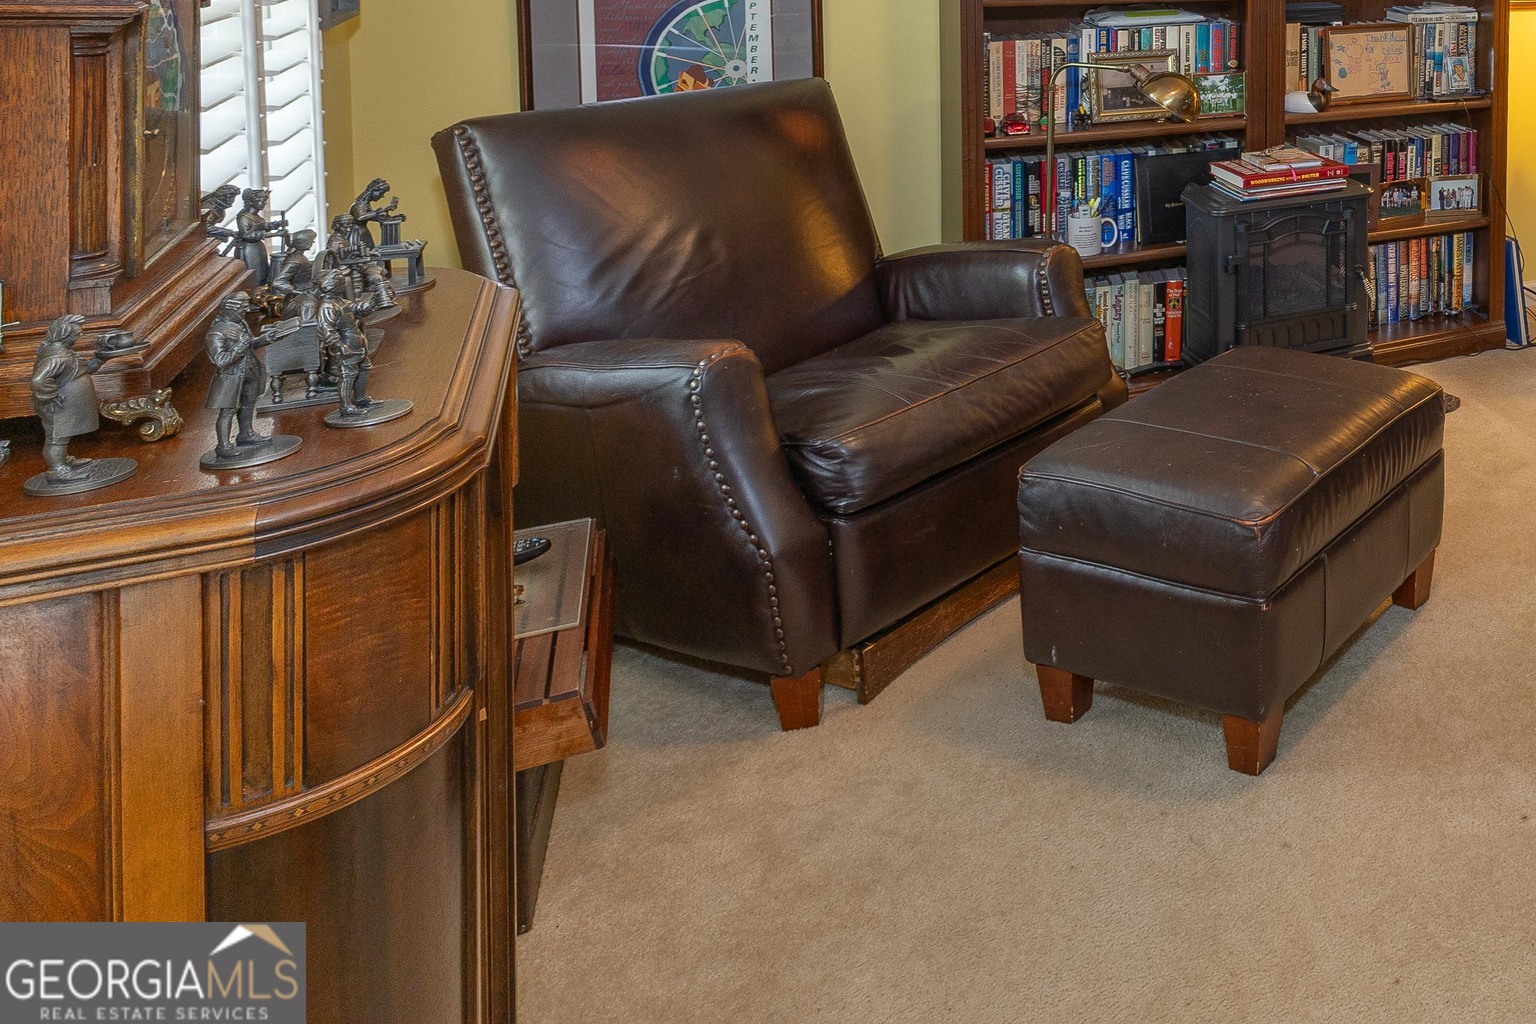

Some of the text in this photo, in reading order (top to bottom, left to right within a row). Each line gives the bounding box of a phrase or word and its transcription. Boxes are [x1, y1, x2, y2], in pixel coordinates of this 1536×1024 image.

[995, 169, 1003, 206] CUSSLER
[1003, 173, 1011, 199] CLIVE
[1058, 162, 1066, 190] CUSSLER
[1121, 160, 1131, 209] CLIVE CUSSLER
[1250, 172, 1320, 186] WOODWORKING ROUTER
[1387, 244, 1396, 257] FOUR
[1113, 294, 1123, 322] Legacy
